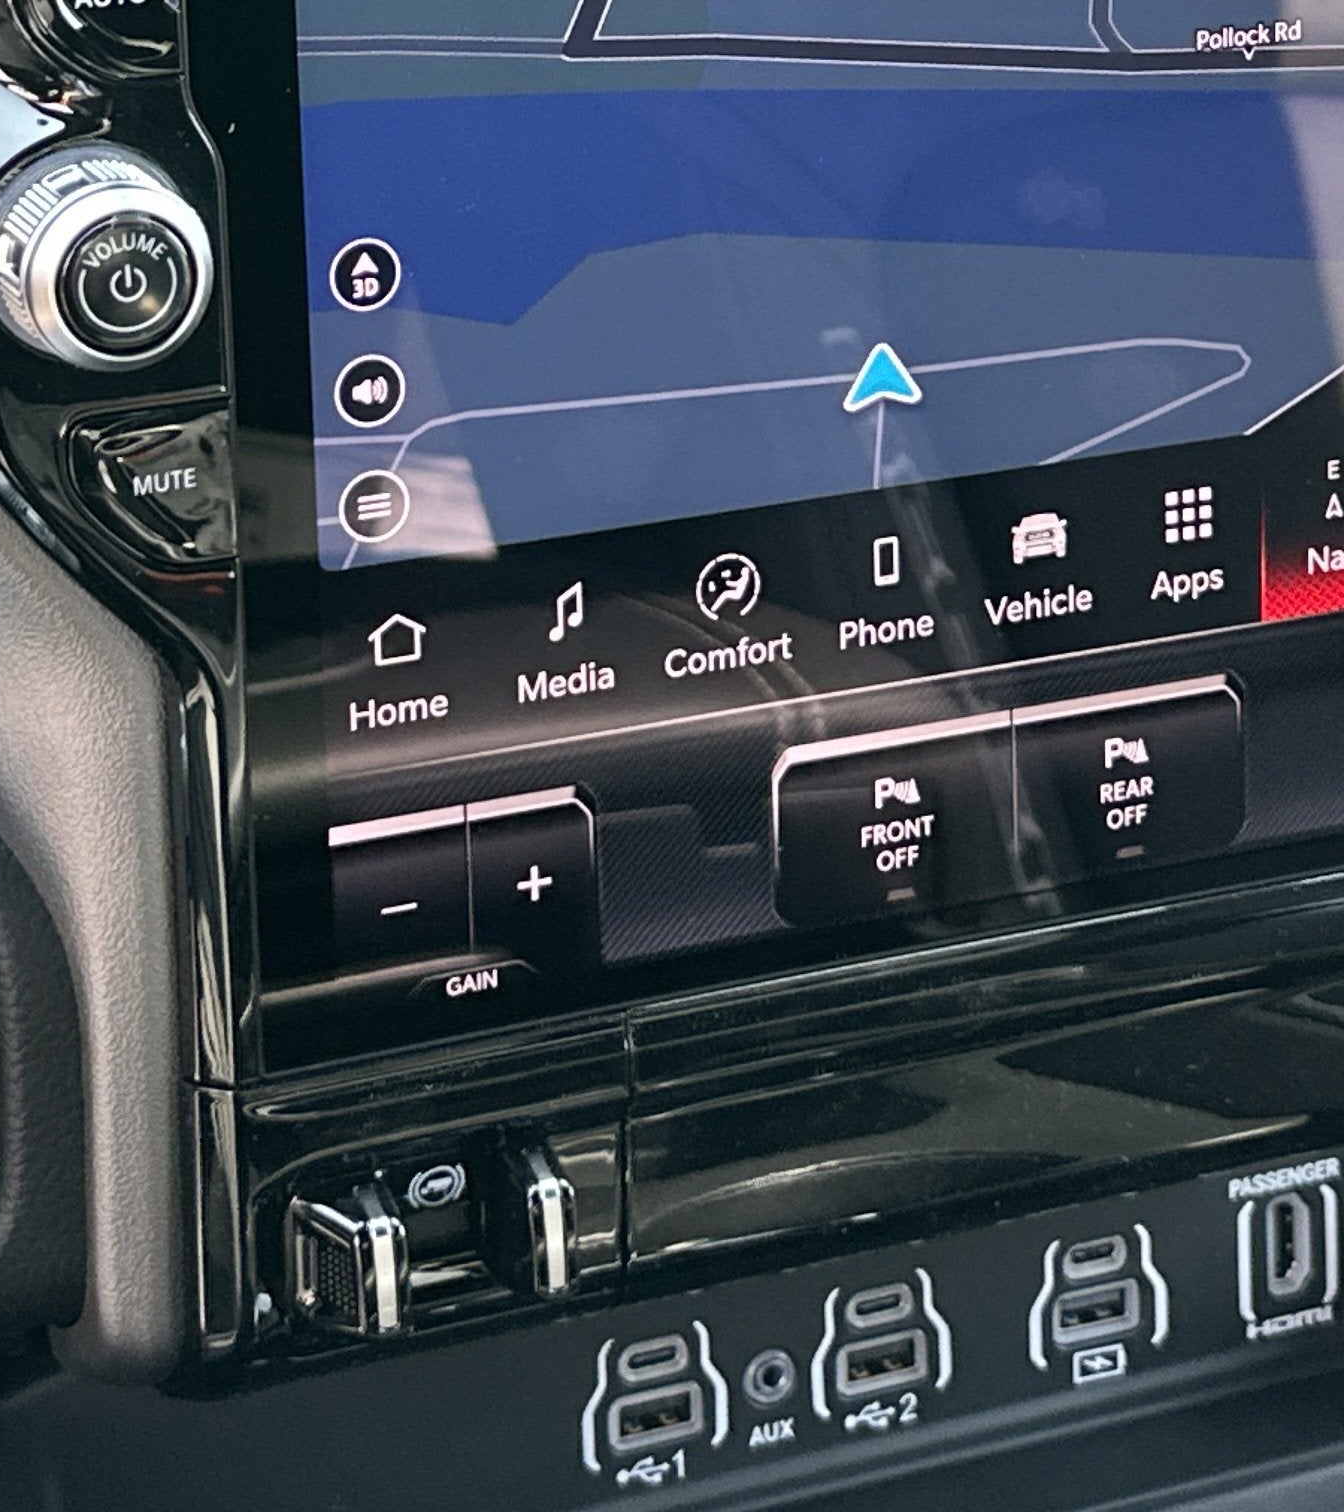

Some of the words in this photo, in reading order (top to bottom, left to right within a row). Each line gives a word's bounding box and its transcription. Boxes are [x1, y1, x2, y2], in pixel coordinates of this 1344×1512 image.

[1196, 22, 1270, 50] Pollock
[1273, 20, 1302, 42] Rd
[83, 232, 169, 272] VOLUME
[352, 277, 379, 300] 3D
[132, 467, 198, 497] MUTE
[1327, 459, 1341, 480] E
[1151, 566, 1224, 602] Apps
[985, 585, 1094, 626] Vehicle
[839, 612, 935, 651] Phone
[665, 633, 793, 678] Comfort
[517, 661, 616, 703] Media
[349, 692, 450, 731] Home
[1099, 776, 1154, 804] REAR
[861, 814, 935, 850] FRONT
[1105, 802, 1148, 831] OFF
[875, 843, 921, 873] OFF
[445, 968, 499, 997] GAIN
[1229, 1157, 1341, 1200] PASSENGER
[898, 1393, 918, 1424] 2
[748, 1417, 796, 1448] AUX
[673, 1449, 687, 1479] 1
